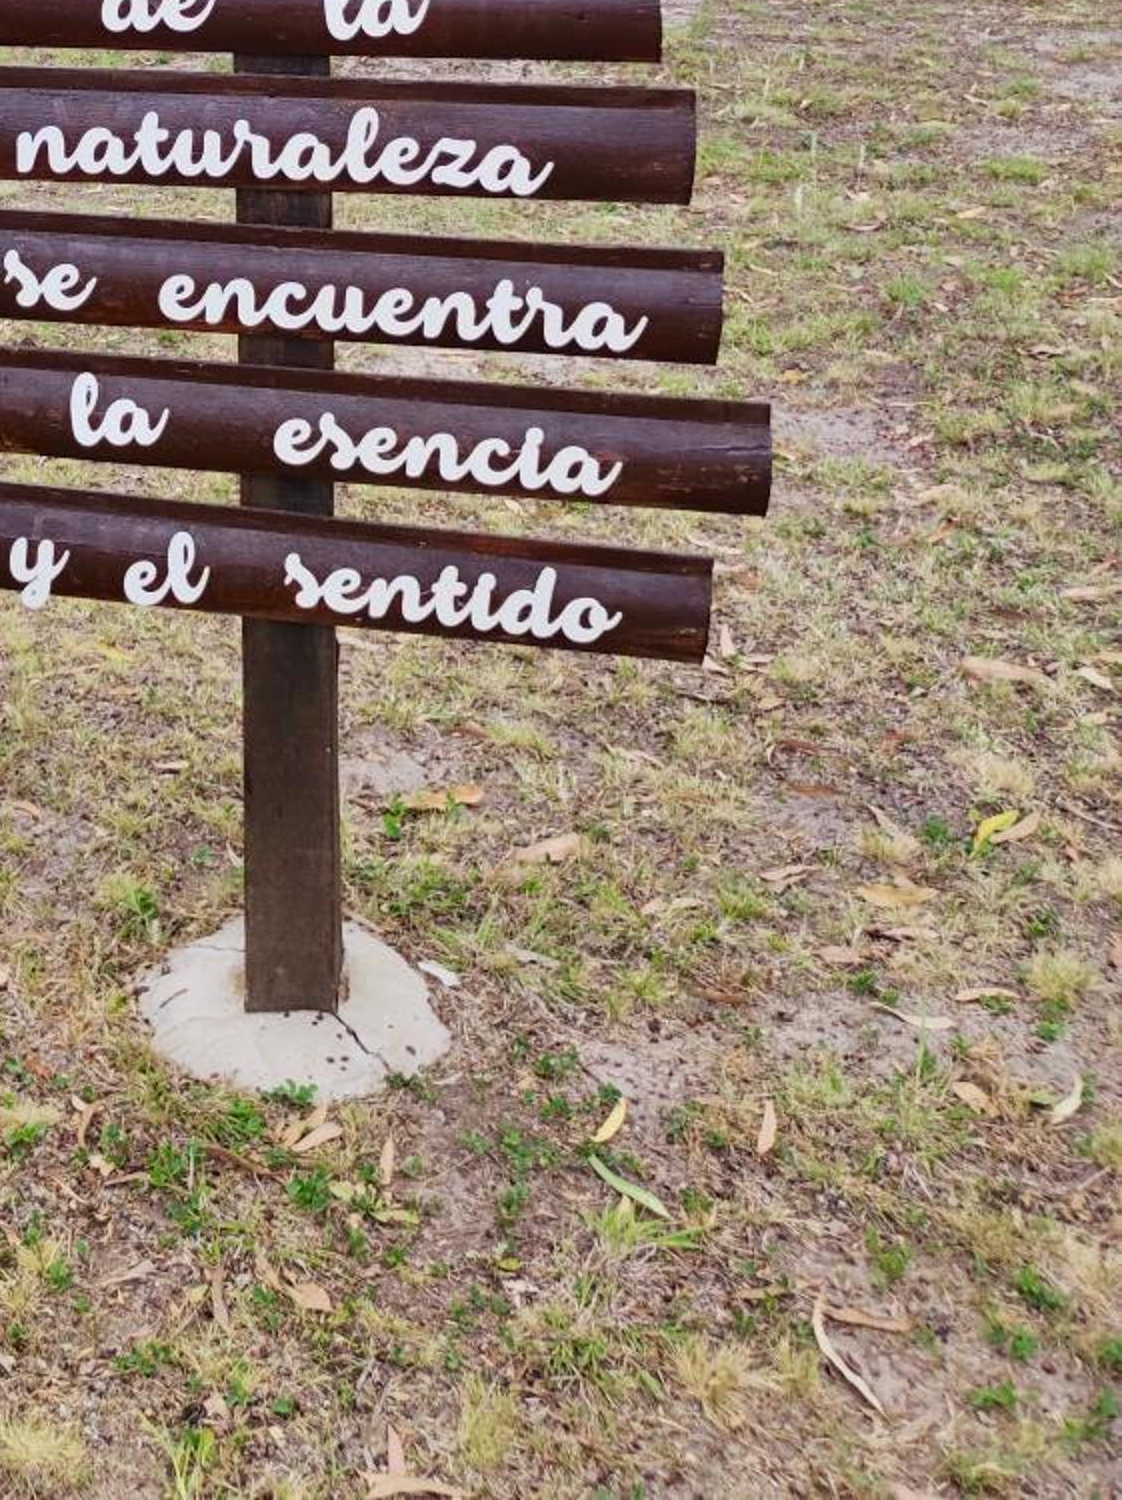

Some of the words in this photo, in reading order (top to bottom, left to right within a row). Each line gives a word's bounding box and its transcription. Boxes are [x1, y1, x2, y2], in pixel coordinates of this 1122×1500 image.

[15, 107, 555, 196] naturaleza
[3, 249, 97, 311] se
[157, 274, 648, 352] encuentra
[69, 371, 170, 447] la
[273, 411, 623, 496] esencia
[8, 536, 69, 611] y
[124, 531, 210, 606] el
[283, 552, 623, 644] sentido
